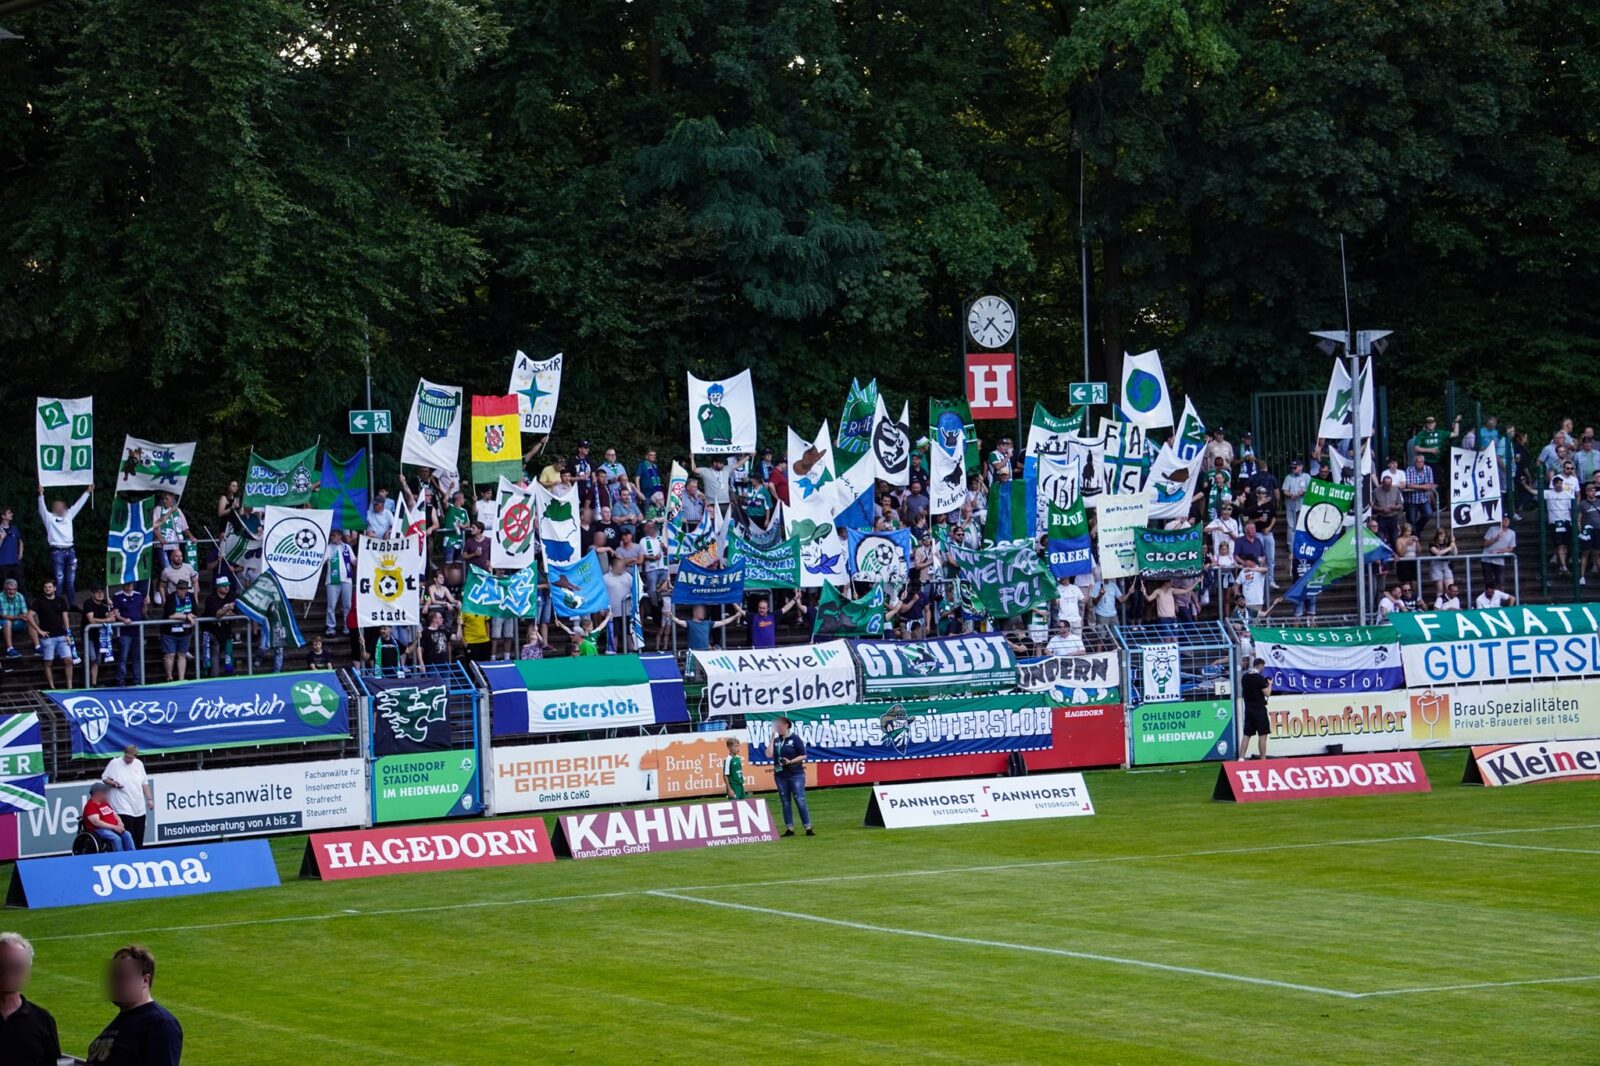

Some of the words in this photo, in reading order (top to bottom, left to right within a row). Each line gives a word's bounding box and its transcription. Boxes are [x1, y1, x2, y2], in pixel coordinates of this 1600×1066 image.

[518, 358, 527, 371] A
[532, 358, 561, 373] STAR
[969, 364, 1013, 408] H
[1052, 510, 1084, 526] BLUE
[1453, 499, 1499, 525] GT
[365, 539, 410, 551] fußball
[1300, 543, 1316, 557] der
[266, 553, 321, 567] Gütersloher
[299, 551, 323, 560] Aktive
[1050, 547, 1090, 564] GREEN
[1145, 551, 1199, 562] CLOCK
[371, 609, 407, 621] stadt
[1280, 628, 1372, 643] Fussball
[738, 652, 819, 672] Aktive
[856, 643, 903, 677] GT
[928, 636, 1011, 674] LEBT
[1274, 669, 1383, 688] Gütersloh
[709, 674, 856, 709] Gütersloher
[1219, 685, 1226, 695] 5
[74, 706, 103, 718] FCG
[109, 699, 178, 728] 4830
[189, 693, 286, 721] Gütersloh
[543, 698, 639, 721] Gütersloh
[1064, 709, 1104, 718] HAGEDORN
[1454, 697, 1579, 718] BrauSpezialitäten
[1142, 710, 1201, 722] OHLENDORF
[1269, 704, 1407, 739] Hohenfelder
[1454, 716, 1532, 729] Privat-Brauerei
[1536, 715, 1555, 725] seit
[1558, 714, 1580, 723] 1845
[911, 707, 1053, 743] GÜTERSLOH
[1142, 721, 1186, 731] STADION
[1142, 734, 1155, 743] IM
[1158, 731, 1214, 742] HEIDEWALD
[382, 761, 446, 774] OHLENDORF
[499, 753, 629, 777] HAMBRINK
[833, 761, 865, 777] GWG
[305, 768, 349, 779] Fachanwälte
[350, 768, 360, 776] für
[382, 773, 429, 785] STADION
[1236, 761, 1417, 793] HAGEDORN
[305, 781, 357, 792] Insolvenzrecht
[515, 771, 616, 792] GRABKE
[667, 777, 681, 792] in
[684, 775, 713, 790] dein
[166, 783, 293, 810] Rechtsanwälte
[383, 787, 397, 799] IM
[399, 783, 459, 797] HEIDEWALD
[538, 791, 559, 803] GmbH
[570, 790, 590, 800] CoKG
[992, 787, 1077, 803] PANNHORST
[306, 795, 342, 805] Strafrecht
[889, 794, 976, 809] PANNHORST
[1034, 801, 1080, 809] ENTSORGUNG
[306, 807, 347, 817] Steuerrecht
[932, 807, 978, 816] ENTSORGUNG
[164, 820, 245, 836] Insolvenzberatung
[247, 819, 263, 828] von
[265, 816, 272, 826] A
[273, 816, 288, 826] bis
[289, 814, 297, 825] Z
[566, 798, 770, 851] KAHMEN
[706, 833, 772, 848] www.kahmen.de
[323, 828, 539, 869] HAGEDORN
[572, 846, 621, 859] TransCargo
[622, 843, 650, 855] GmbH
